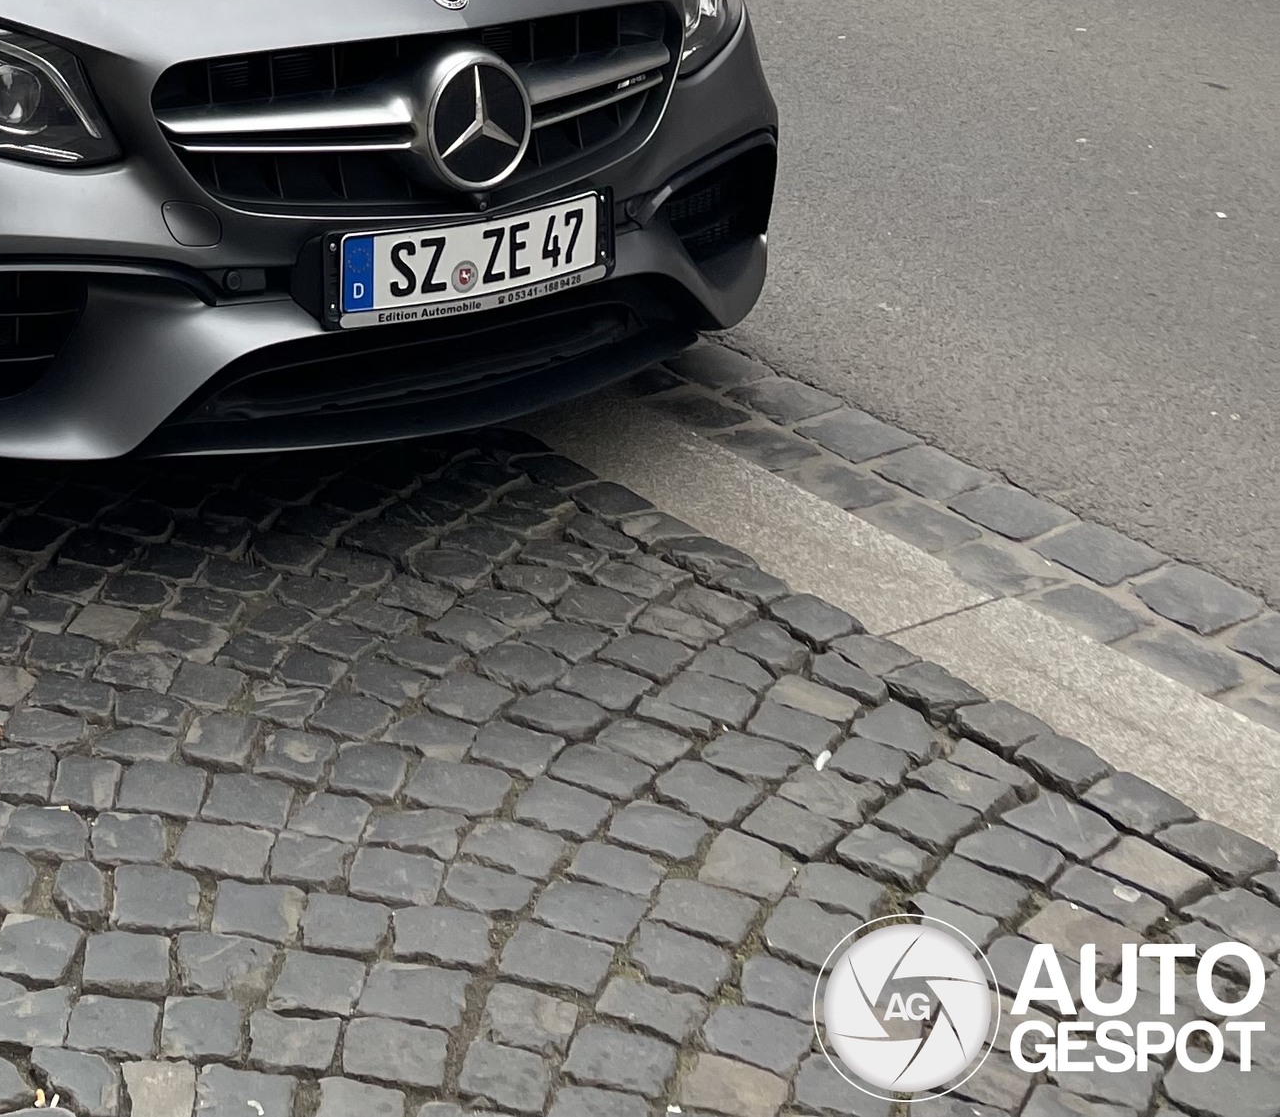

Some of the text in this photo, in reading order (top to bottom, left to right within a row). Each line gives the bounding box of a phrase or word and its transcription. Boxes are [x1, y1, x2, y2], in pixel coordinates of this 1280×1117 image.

[389, 208, 584, 298] SZ ZE 47
[352, 281, 365, 300] D
[377, 310, 418, 324] Edition
[420, 300, 482, 319] Automobile
